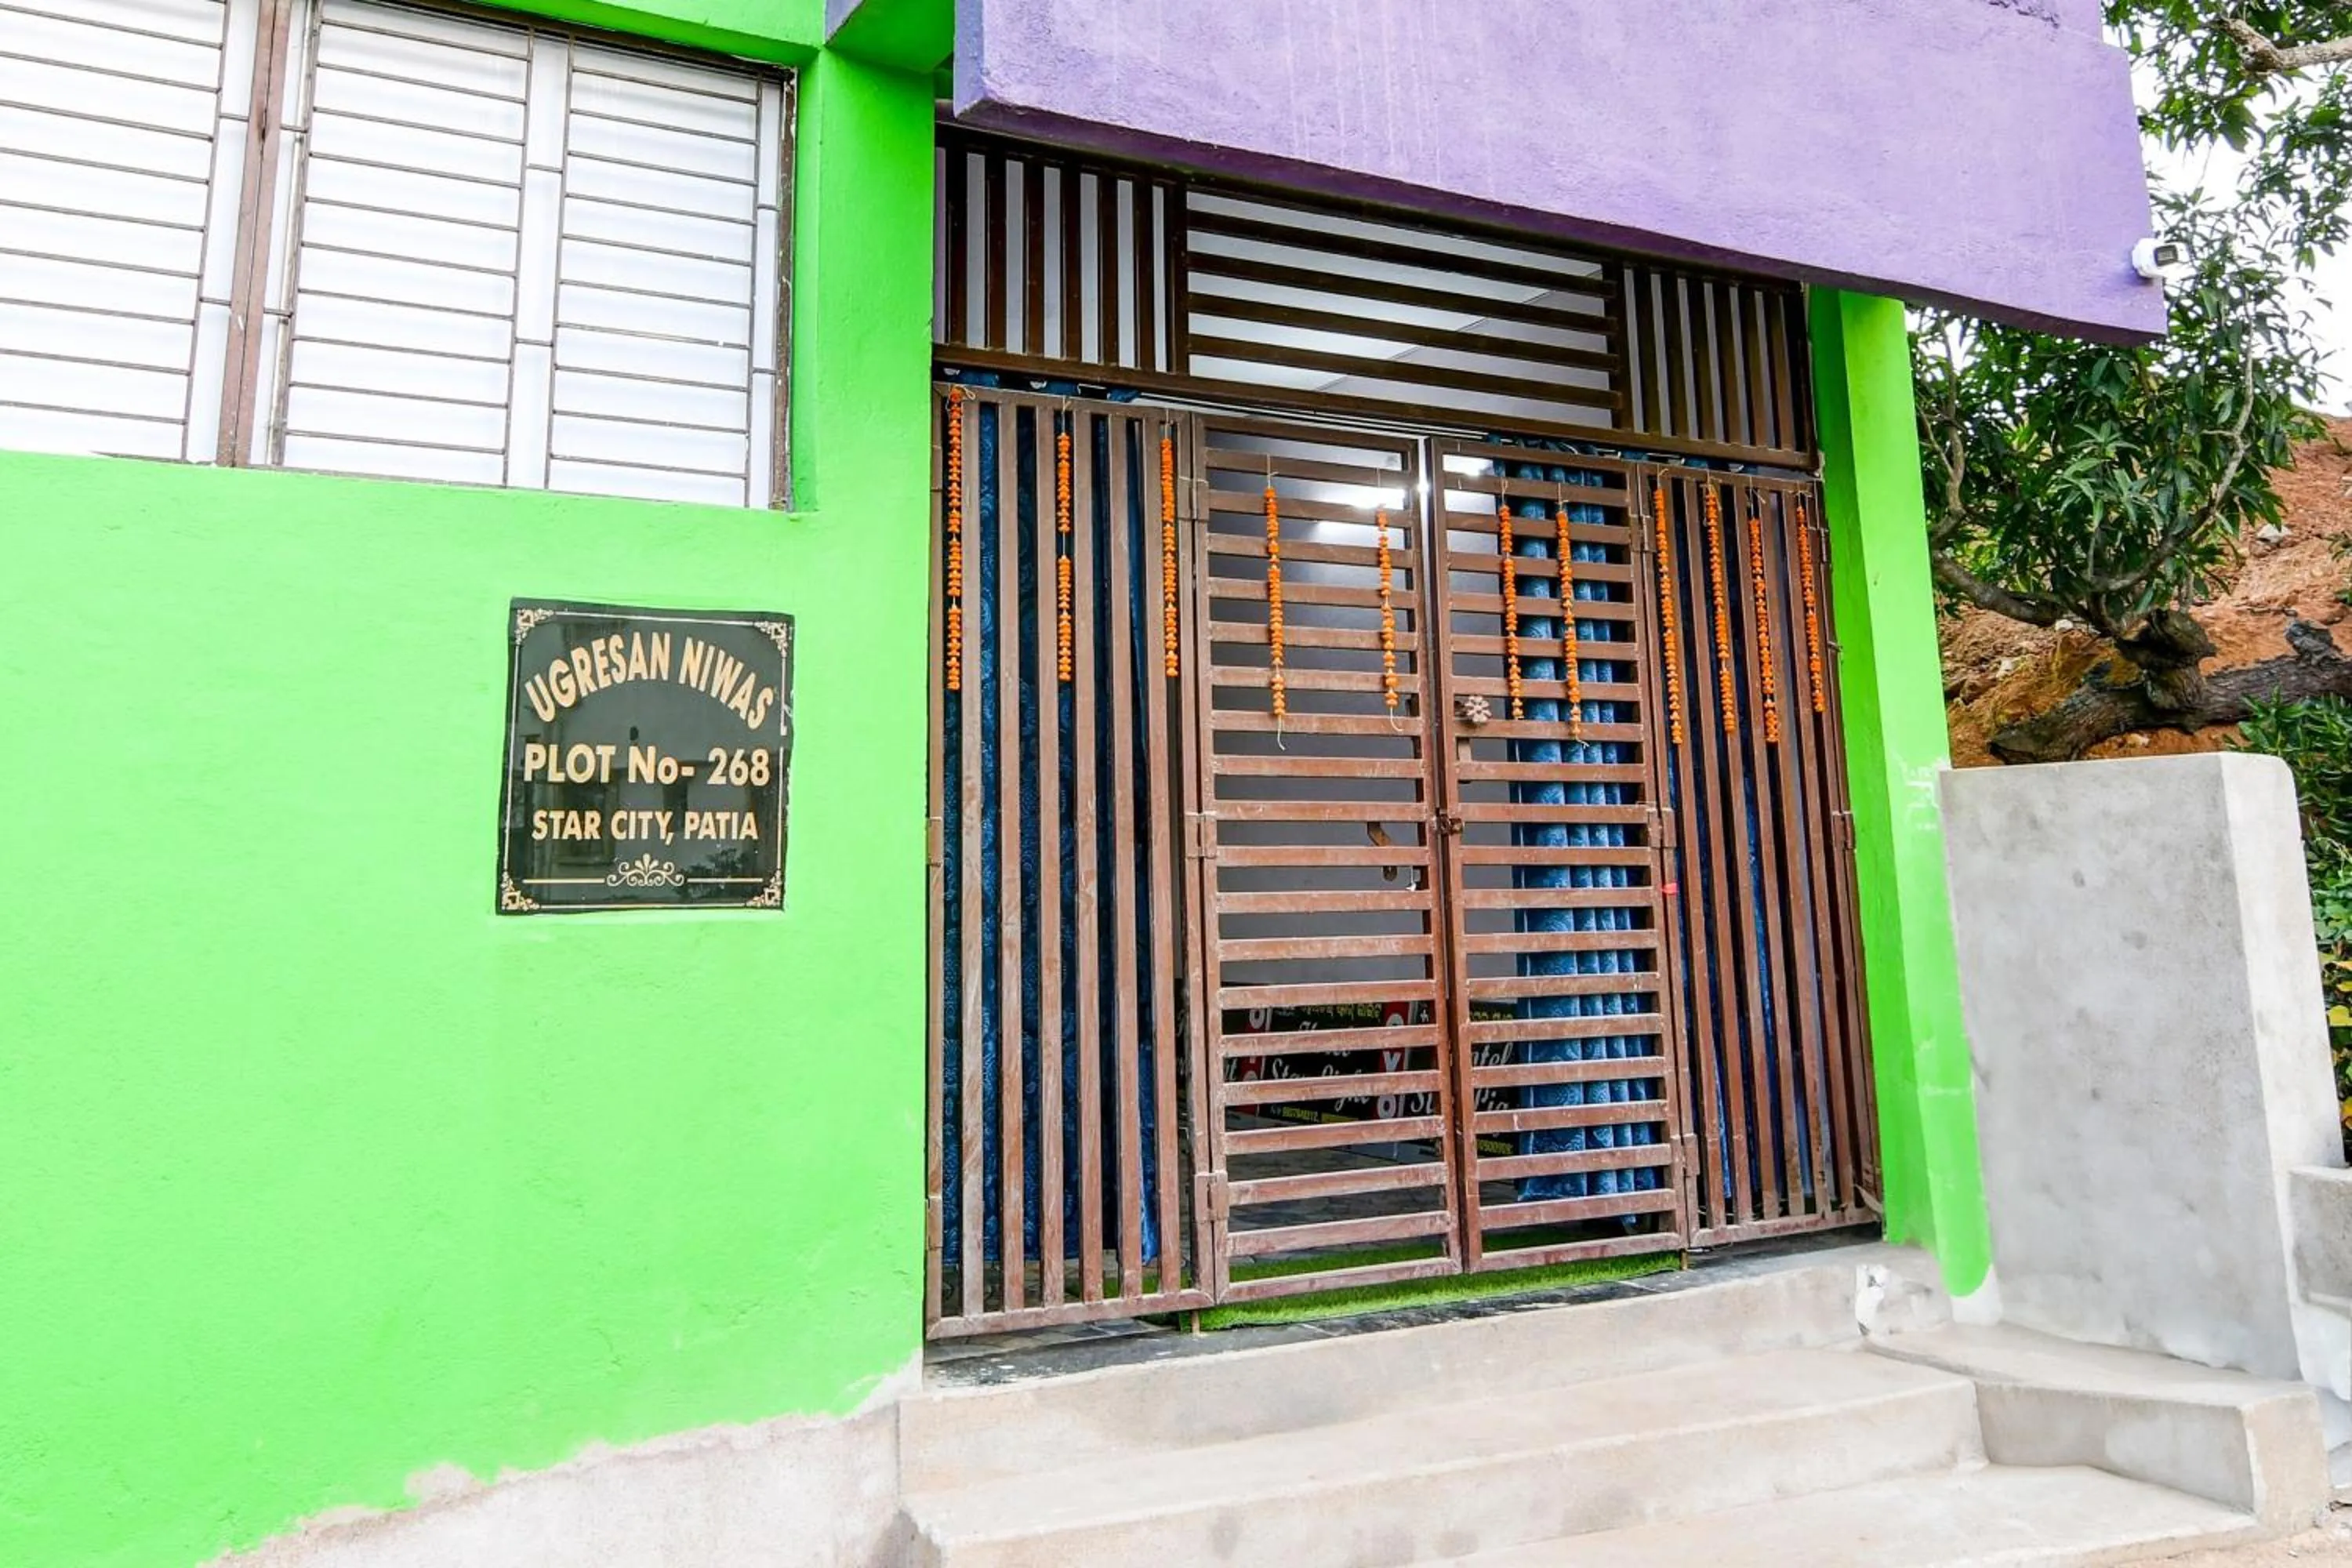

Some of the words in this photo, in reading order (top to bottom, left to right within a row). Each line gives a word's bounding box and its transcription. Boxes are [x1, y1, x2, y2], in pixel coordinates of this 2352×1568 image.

[524, 631, 671, 722] UGRESAN
[678, 637, 774, 730] NIWAS
[523, 743, 617, 783] PLOT
[628, 745, 695, 784] No-
[706, 747, 770, 786] 268
[532, 809, 601, 840] STAR
[611, 810, 674, 846] CITY,
[684, 811, 758, 840] PATIA
